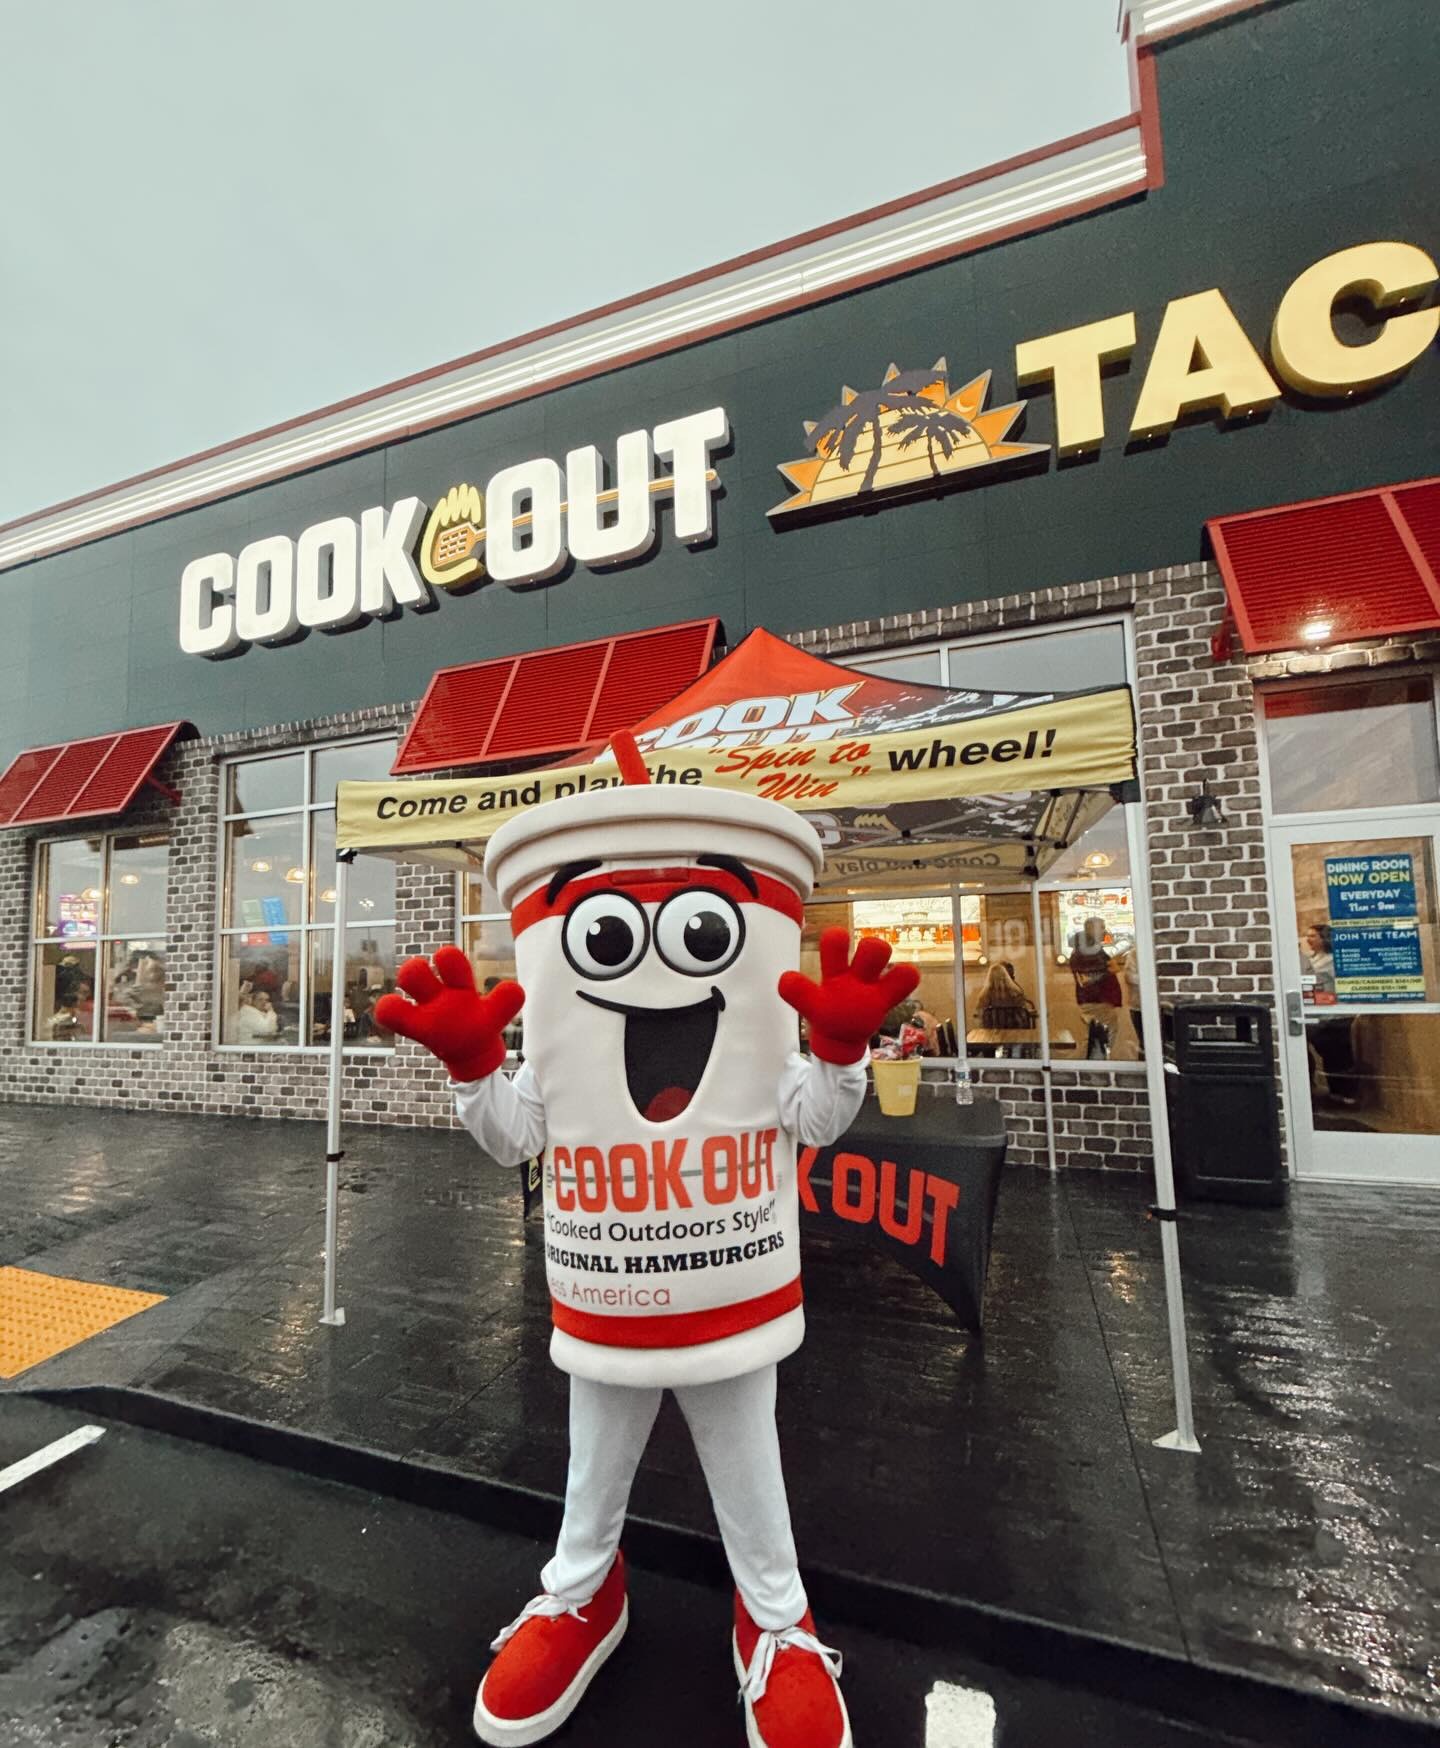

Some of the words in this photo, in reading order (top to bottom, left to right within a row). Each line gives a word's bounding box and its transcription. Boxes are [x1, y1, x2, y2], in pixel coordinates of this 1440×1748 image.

[1015, 241, 1440, 455] TAC
[179, 496, 428, 656] COOK
[485, 407, 731, 586] OUT
[829, 741, 872, 765] to
[888, 728, 1058, 772] wheel!
[377, 794, 468, 820] Come
[477, 781, 541, 811] and
[647, 763, 703, 786] he
[1326, 861, 1370, 873] DINING
[1371, 859, 1410, 870] ROOM
[1327, 873, 1364, 886] NOW
[1369, 870, 1410, 884] OPEN
[1340, 888, 1401, 901] EVERYDAY
[1334, 933, 1360, 942] JOIN
[1361, 931, 1383, 941] THE
[1385, 930, 1418, 940] TEAM
[553, 1137, 694, 1213] COOK
[701, 1127, 779, 1206] OUT
[831, 1151, 961, 1269] OUT
[608, 1217, 726, 1242] Outdoors
[624, 1231, 785, 1274] HAMBURGERS
[571, 1281, 672, 1307] America
